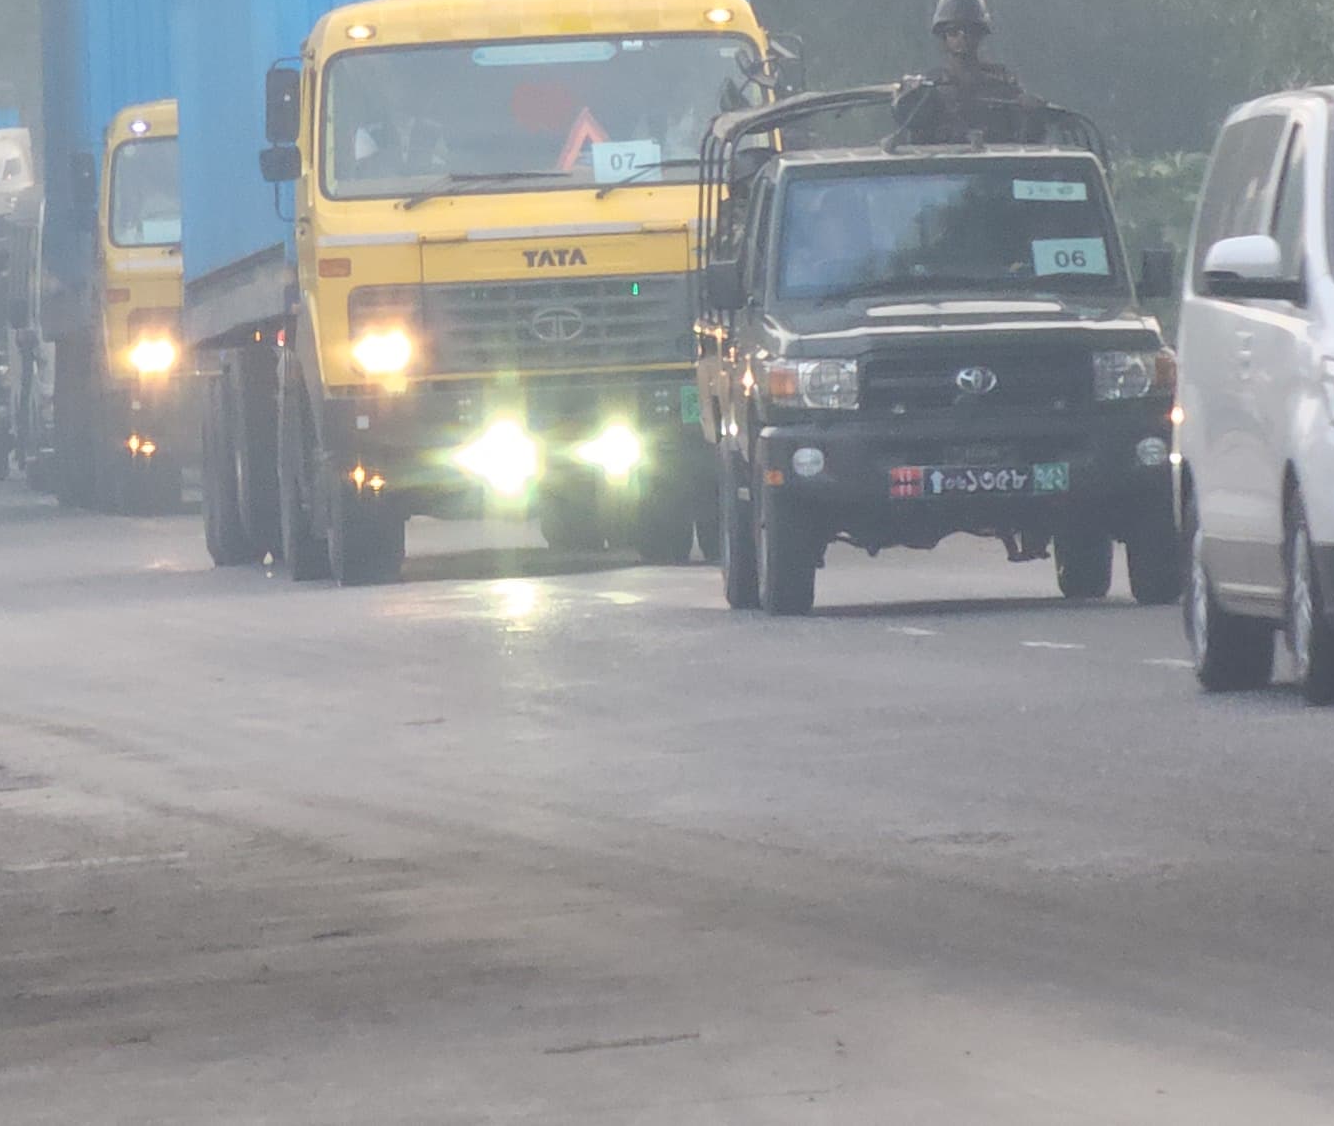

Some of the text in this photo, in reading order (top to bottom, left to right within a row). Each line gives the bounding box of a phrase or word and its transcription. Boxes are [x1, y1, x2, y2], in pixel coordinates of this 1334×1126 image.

[610, 153, 636, 171] 07
[522, 247, 588, 268] TATA
[1054, 250, 1087, 268] 06
